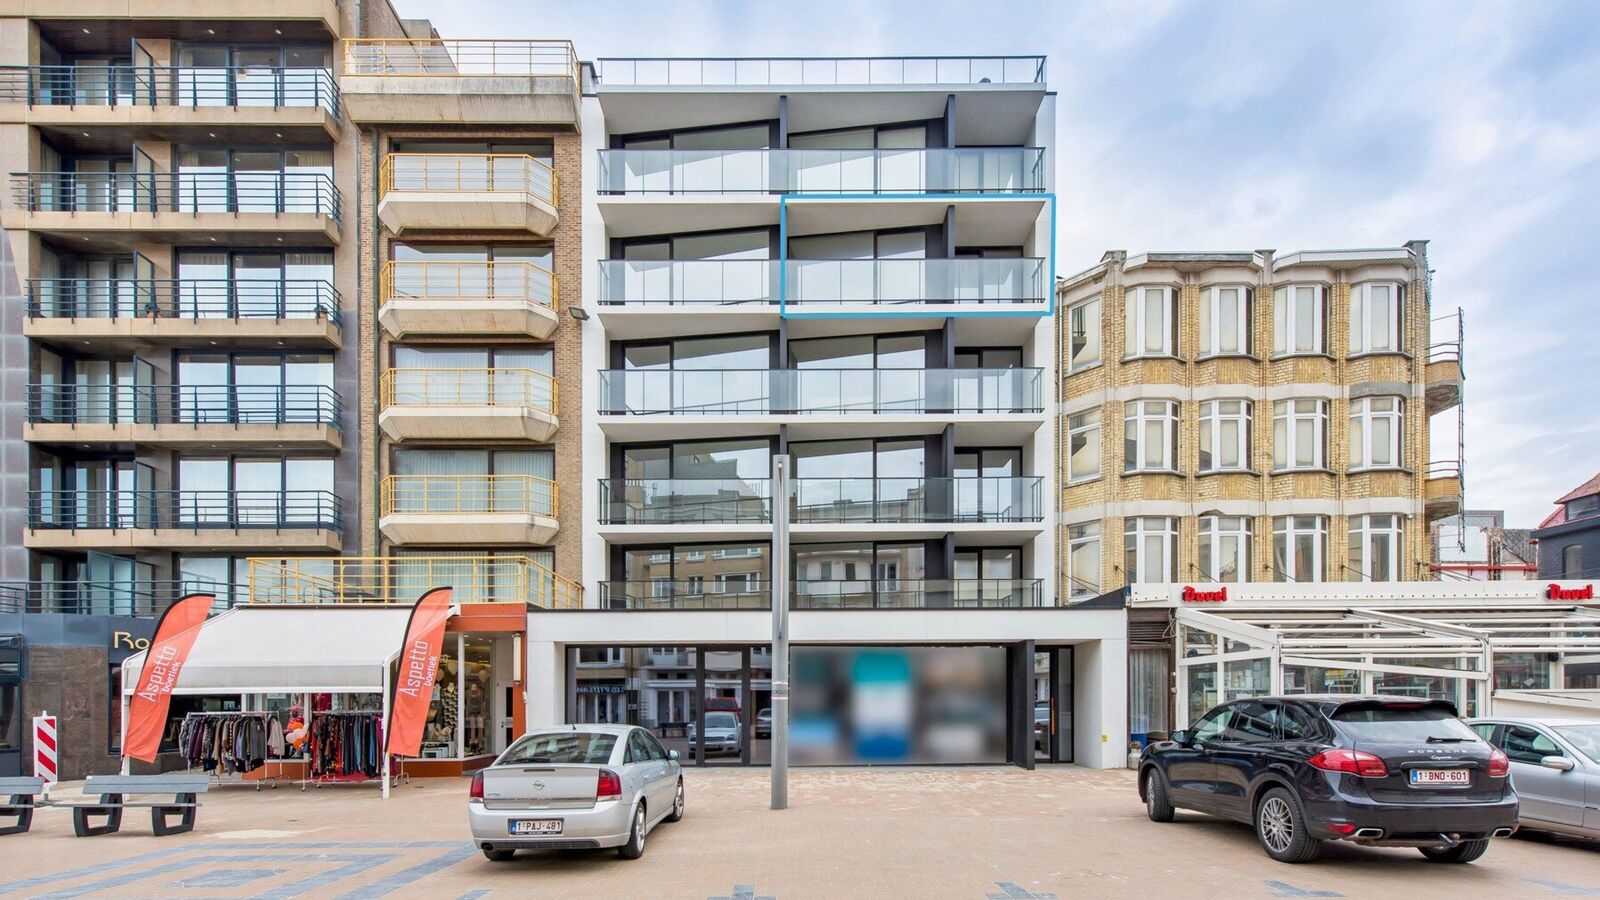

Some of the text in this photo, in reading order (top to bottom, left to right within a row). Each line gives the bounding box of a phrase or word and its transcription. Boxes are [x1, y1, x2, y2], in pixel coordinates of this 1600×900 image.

[1182, 586, 1227, 602] Duvel
[1545, 583, 1594, 600] Duvel
[113, 631, 151, 650] Ro
[136, 646, 177, 703] Aspetto
[161, 661, 181, 693] boetiek
[399, 640, 428, 697] Aspetto
[423, 655, 438, 687] boetiek
